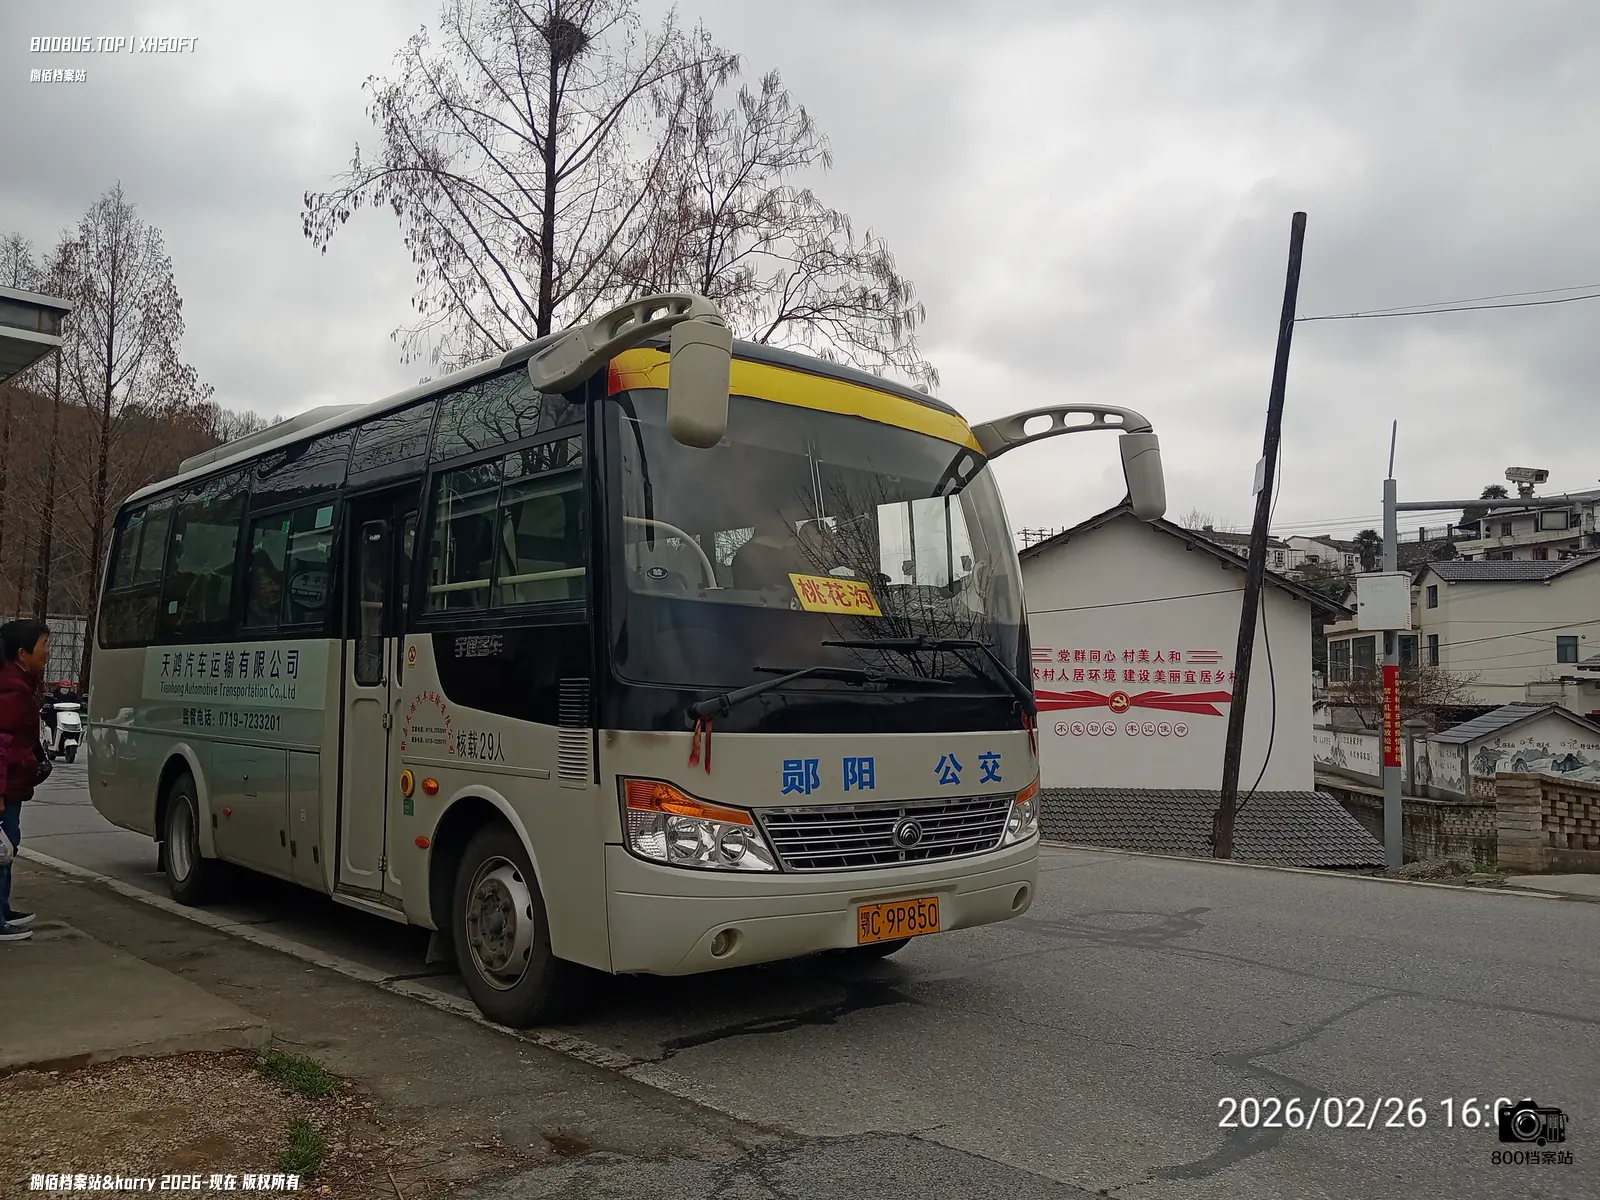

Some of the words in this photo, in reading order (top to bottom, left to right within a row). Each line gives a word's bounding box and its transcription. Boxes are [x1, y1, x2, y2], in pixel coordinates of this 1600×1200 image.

[797, 578, 875, 611] 桃花沟
[160, 649, 300, 680] 天鸿汽车运输有限公司
[1058, 649, 1117, 663] 党群同心
[1123, 649, 1181, 663] 村美人和
[160, 681, 185, 697] Tianhong
[185, 682, 218, 696] Automotive
[219, 683, 268, 699] Transportation
[1055, 722, 1116, 735] 不忘初心
[1126, 723, 1187, 736] 牢记使命
[456, 729, 505, 762] 核载29人
